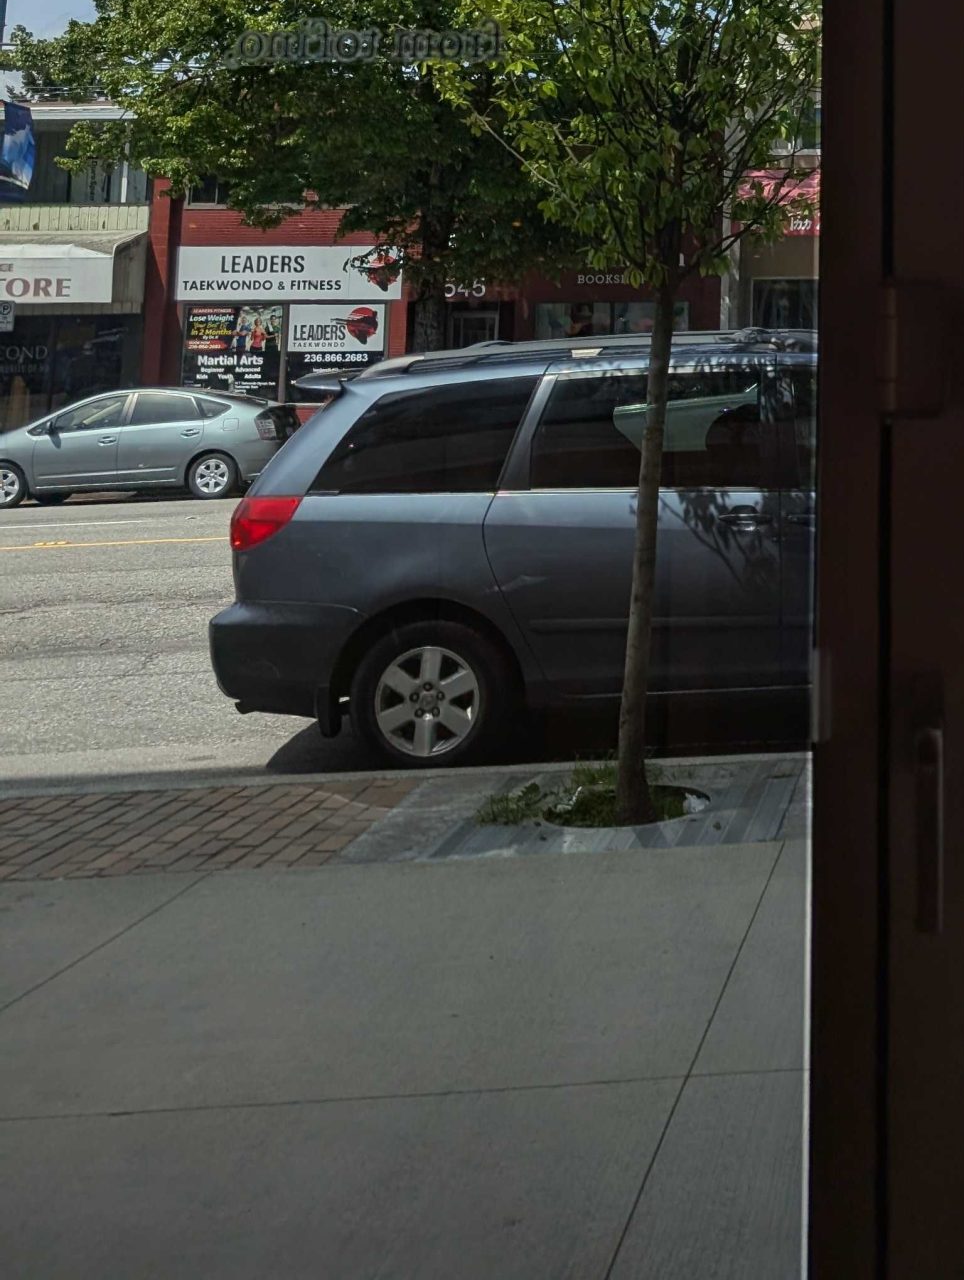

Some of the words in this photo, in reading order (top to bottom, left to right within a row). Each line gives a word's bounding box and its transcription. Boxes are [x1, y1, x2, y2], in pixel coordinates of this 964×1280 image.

[221, 255, 305, 274] LEADERS
[183, 279, 273, 291] TAEKWONDO
[277, 281, 285, 290] &
[290, 279, 342, 291] FITNESS
[207, 314, 235, 322] Weight
[293, 324, 346, 341] LEADERS
[197, 355, 237, 366] Martial
[239, 355, 264, 366] Arts
[304, 353, 369, 363] 236.866.2683
